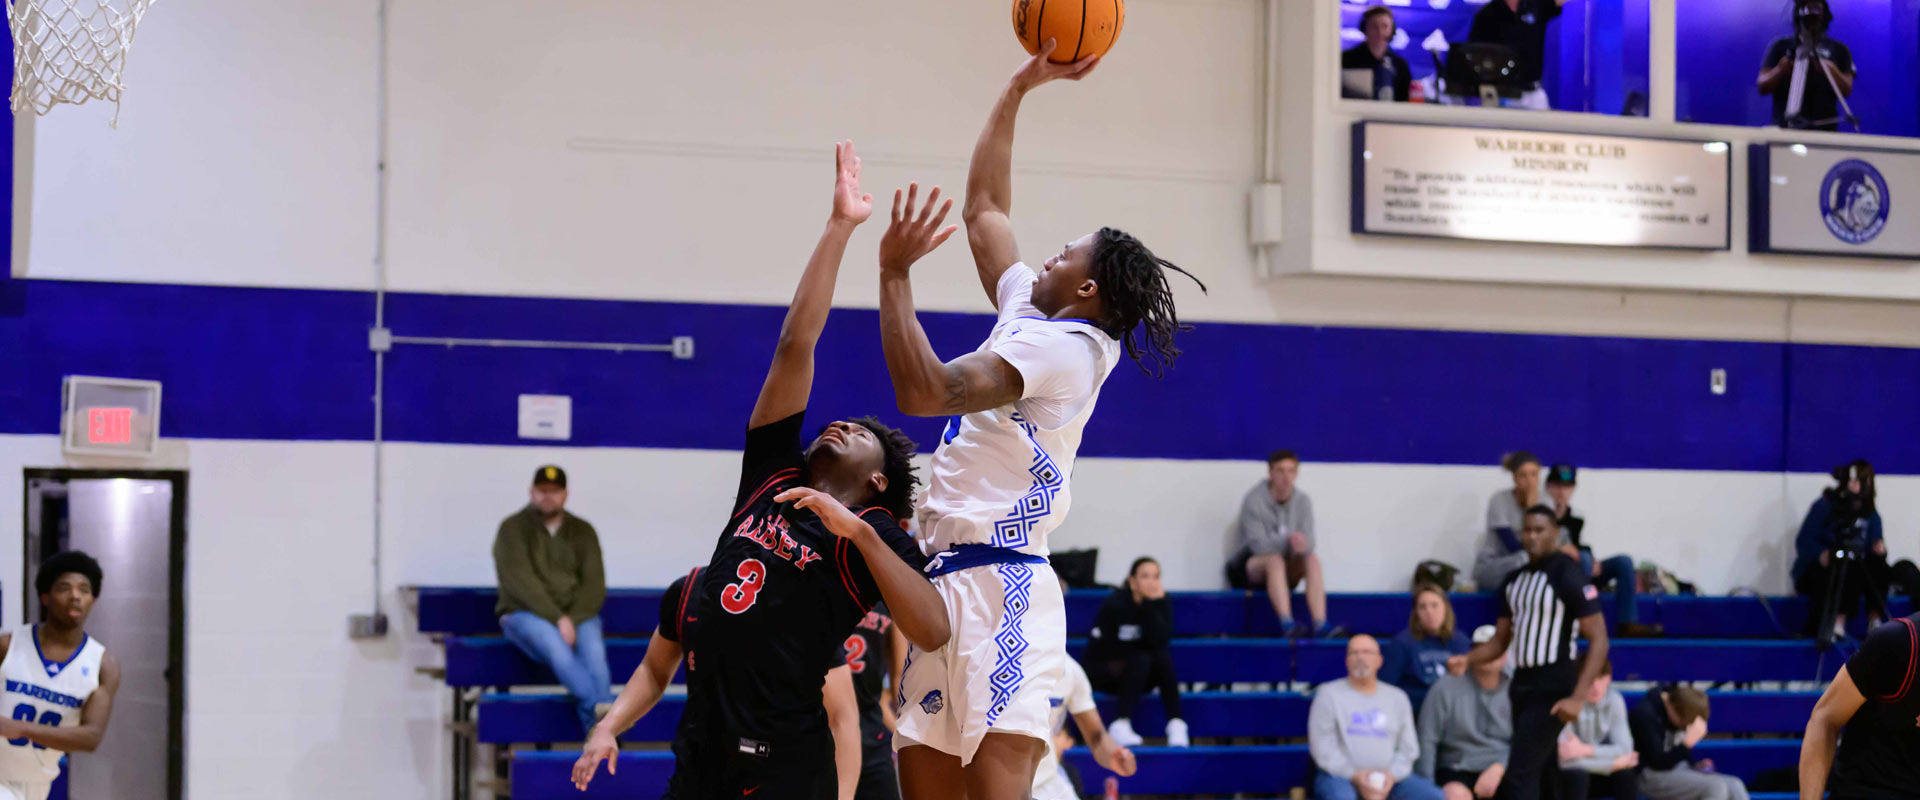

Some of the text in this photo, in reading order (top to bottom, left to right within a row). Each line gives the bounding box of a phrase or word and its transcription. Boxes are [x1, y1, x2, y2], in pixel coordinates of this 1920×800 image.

[1474, 137, 1627, 158] WARRIOR CLUB
[1512, 156, 1589, 173] MISSION
[89, 407, 132, 444] EXIT
[720, 558, 766, 615] 3
